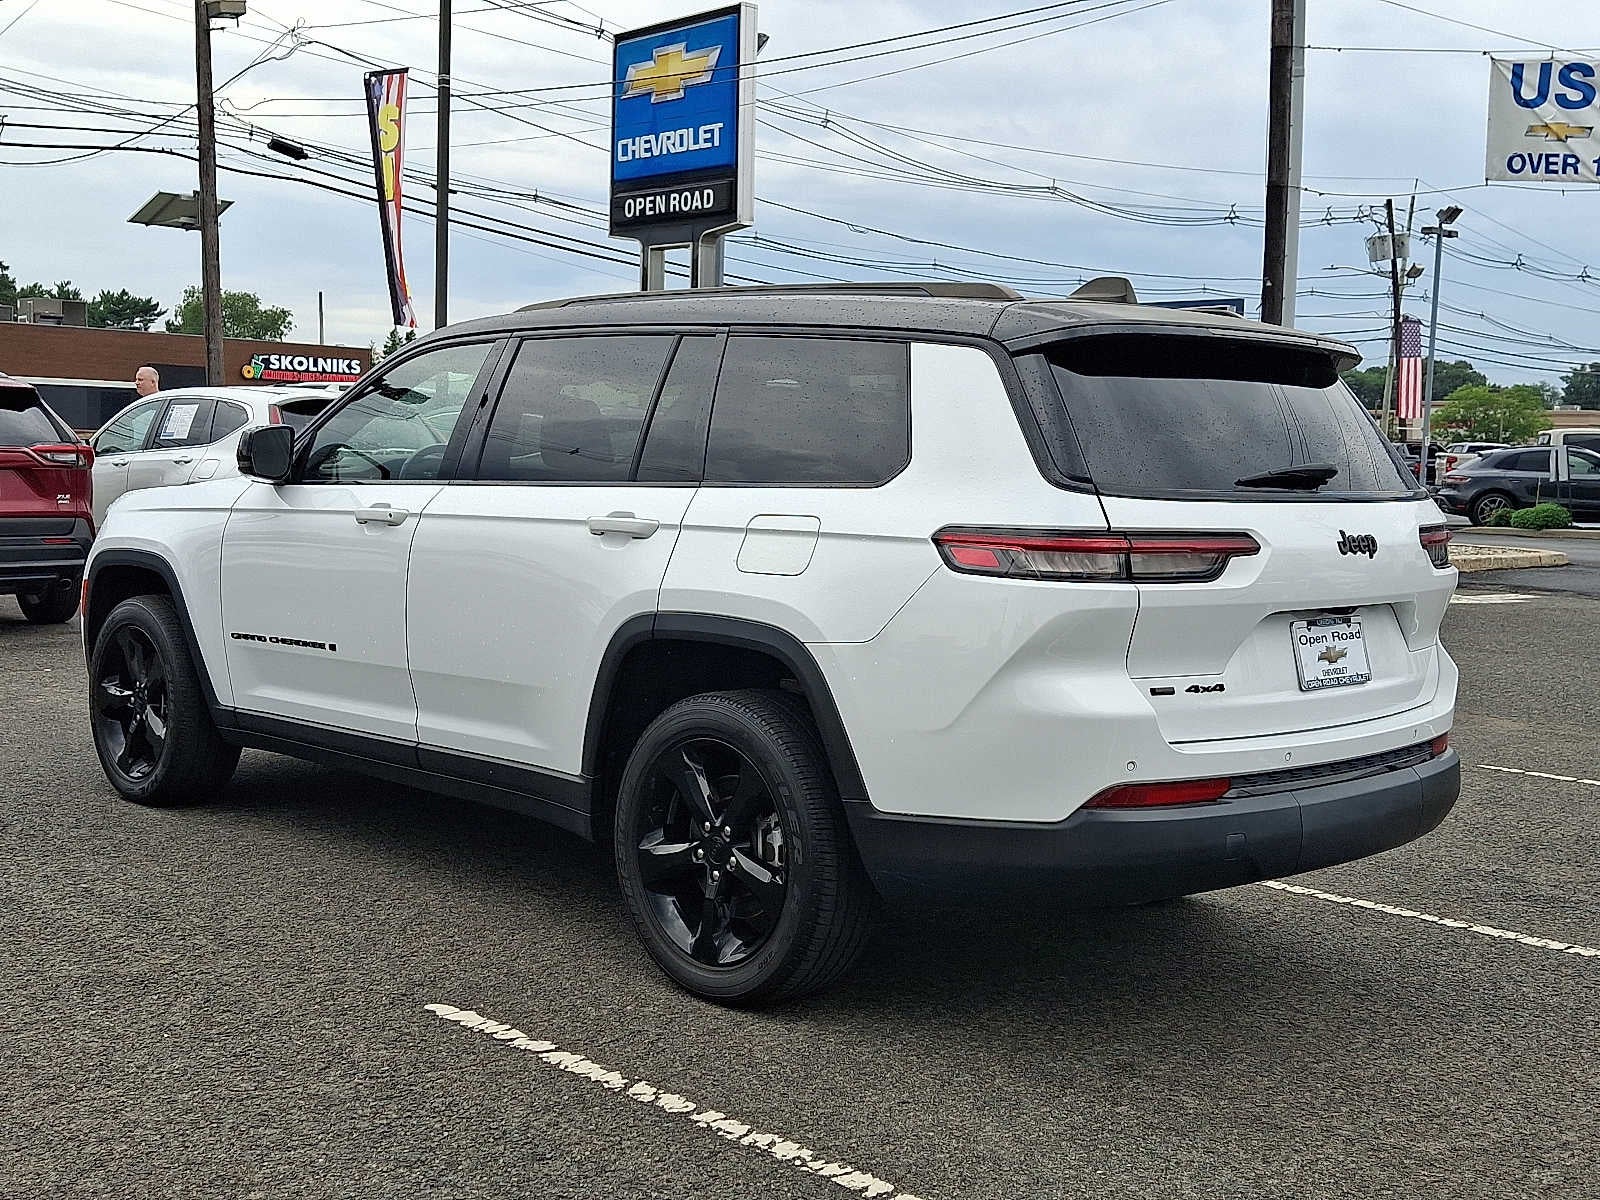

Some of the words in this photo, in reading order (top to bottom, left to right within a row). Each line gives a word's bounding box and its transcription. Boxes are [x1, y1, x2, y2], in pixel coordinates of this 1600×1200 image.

[617, 122, 724, 162] CHEVROLET
[1506, 153, 1580, 175] OVER
[624, 194, 666, 218] OPEN
[669, 188, 714, 213] ROAD
[269, 354, 361, 374] SKOLNIKS
[1336, 529, 1378, 560] Jeep
[231, 633, 267, 642] GRAND
[269, 637, 326, 649] CHEROKEE
[1298, 634, 1328, 648] Open
[1331, 629, 1361, 642] Road
[1184, 683, 1226, 694] 4x4
